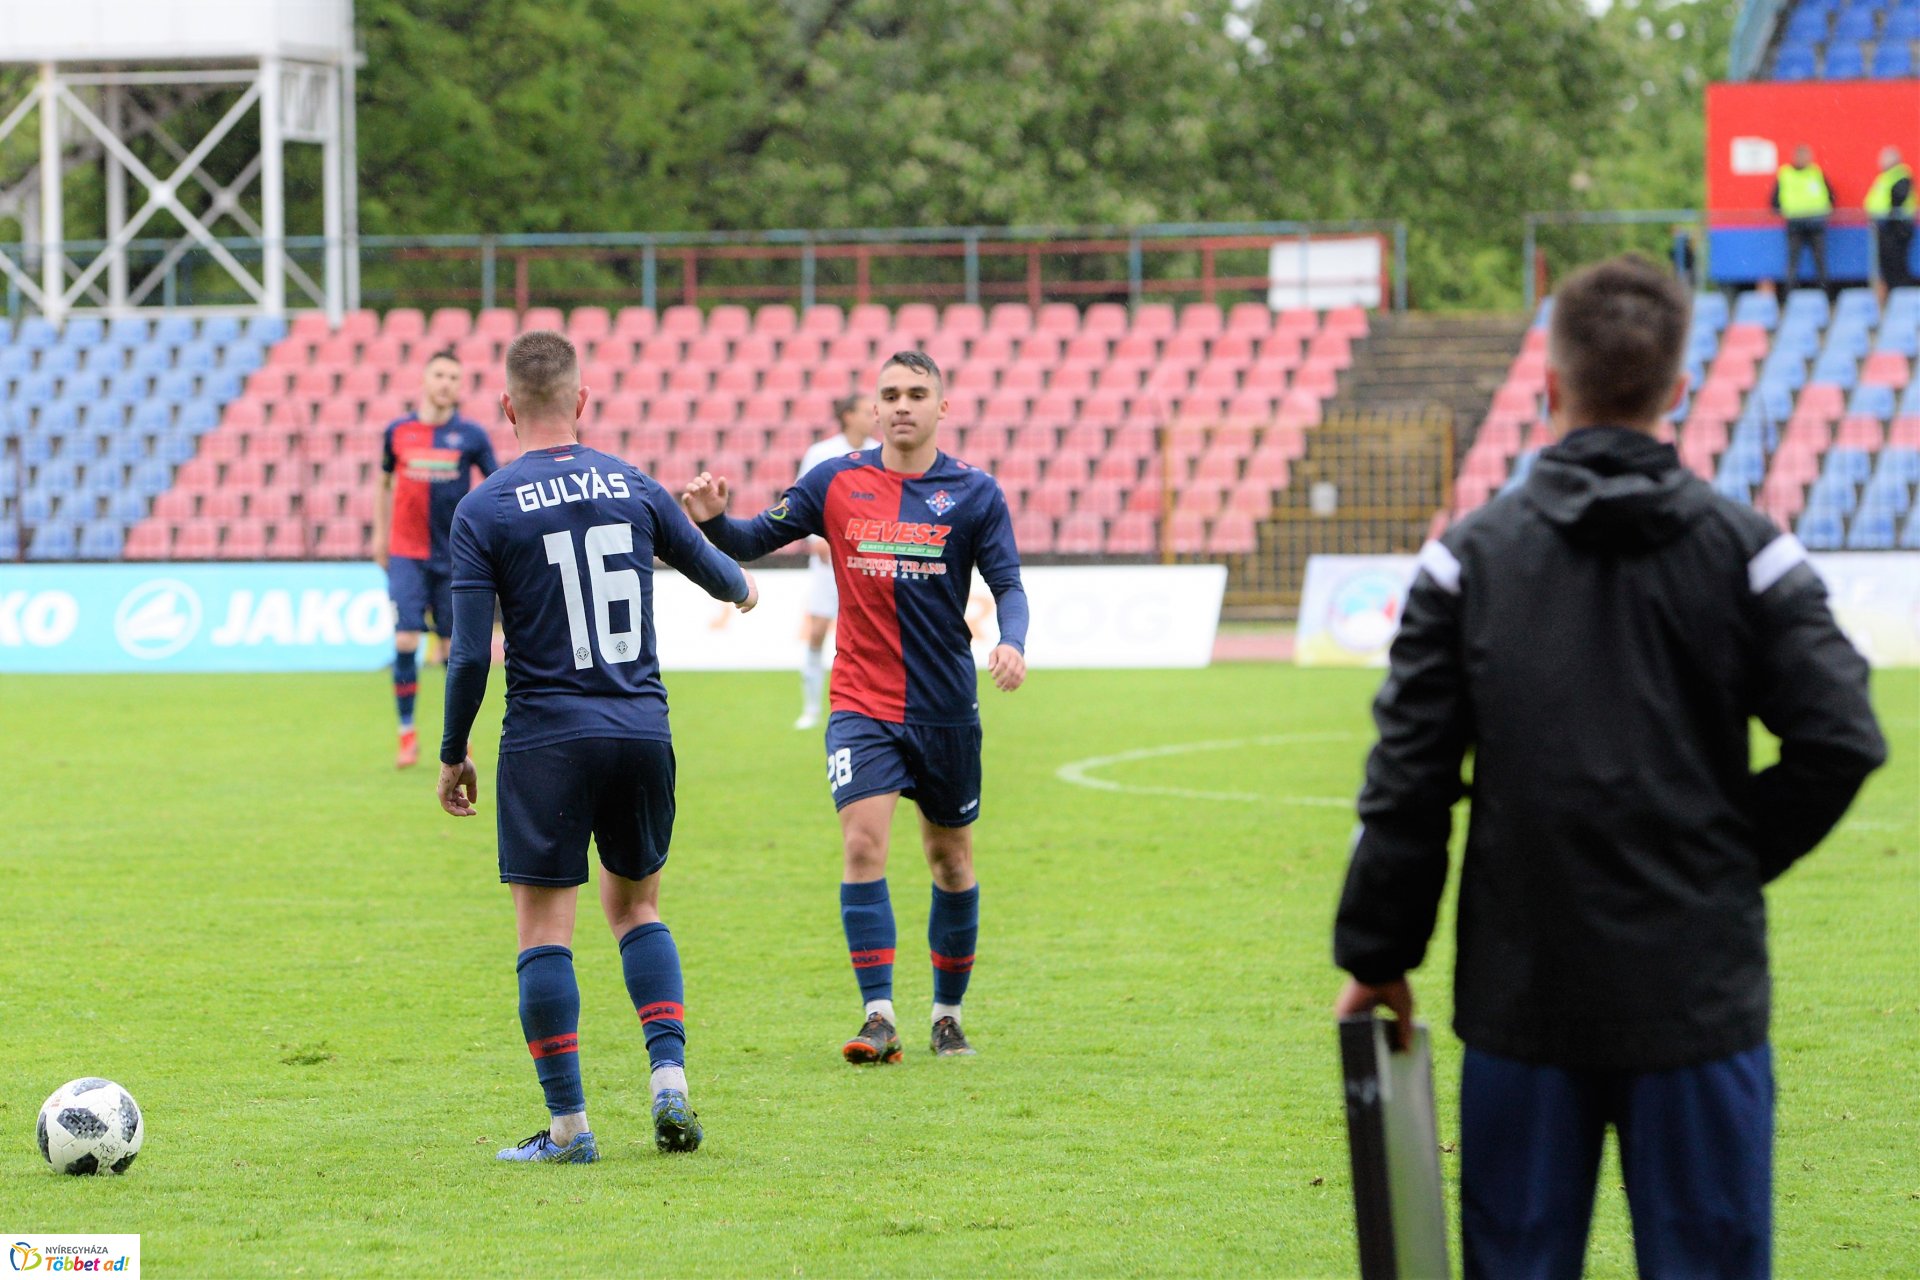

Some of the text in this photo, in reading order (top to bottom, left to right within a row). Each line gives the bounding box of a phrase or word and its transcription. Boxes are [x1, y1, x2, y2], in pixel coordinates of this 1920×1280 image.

[515, 467, 630, 513] GULYÁS
[899, 560, 947, 575] TRANS
[210, 589, 398, 647] JAKO
[543, 522, 642, 670] 16
[827, 748, 853, 794] 28
